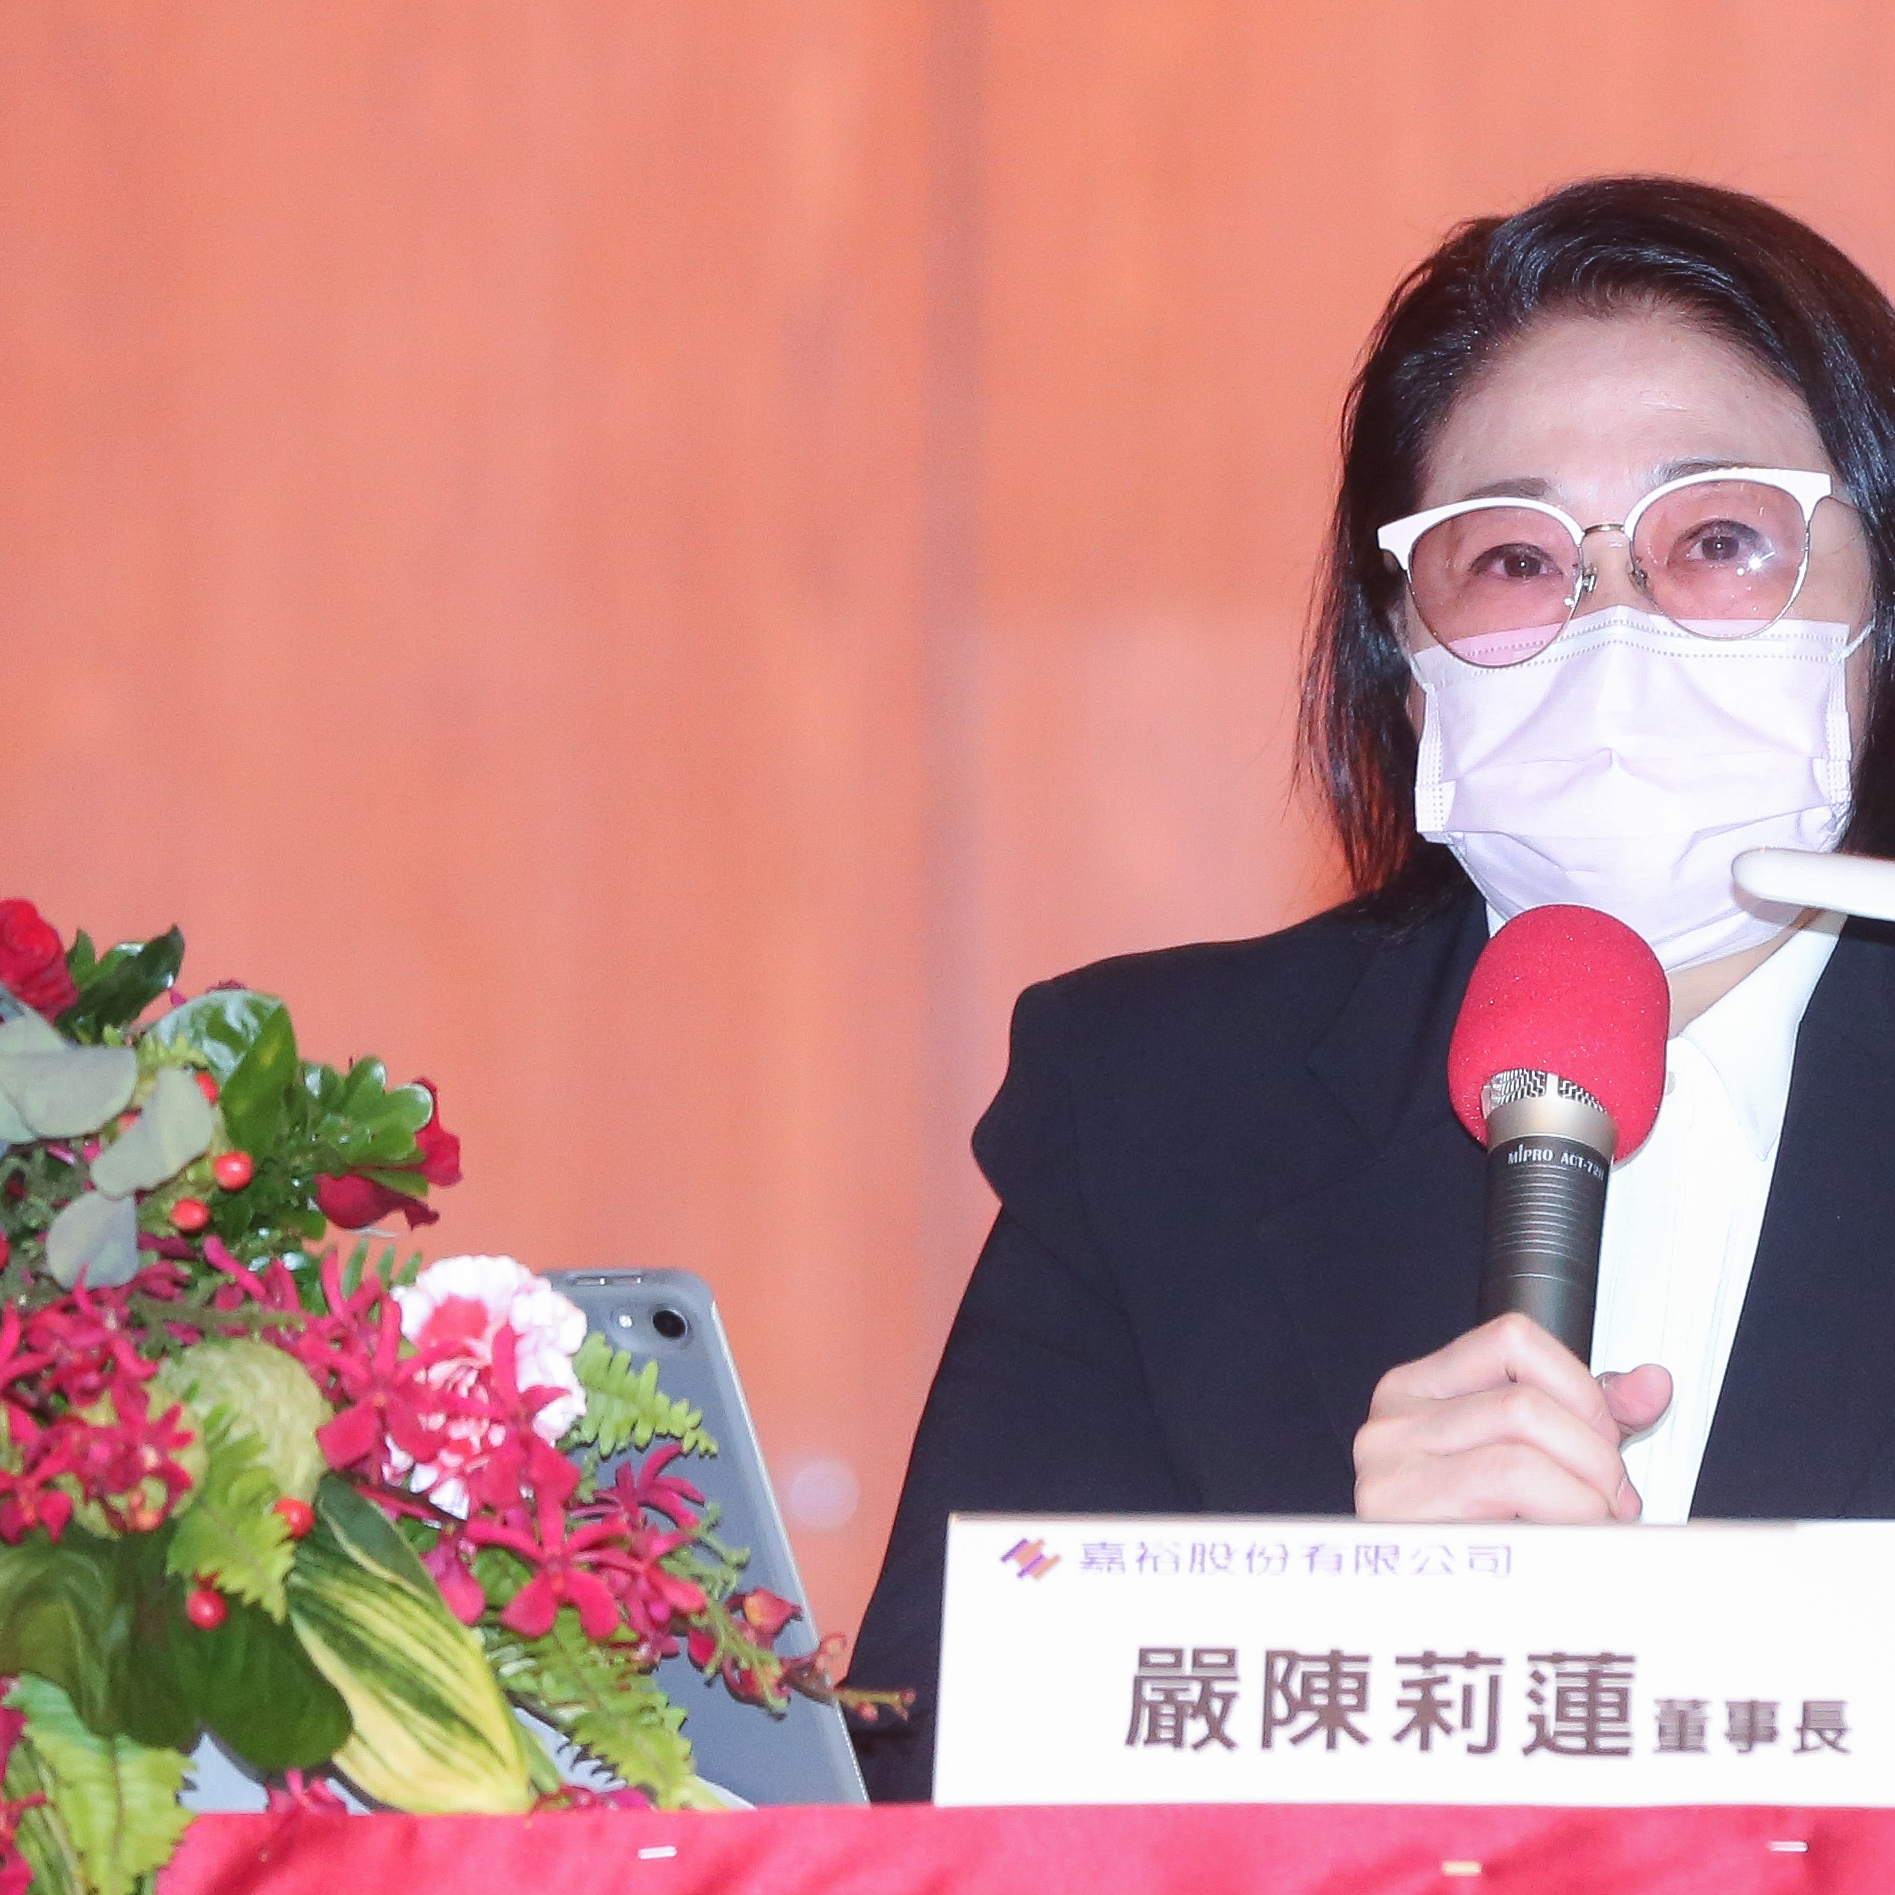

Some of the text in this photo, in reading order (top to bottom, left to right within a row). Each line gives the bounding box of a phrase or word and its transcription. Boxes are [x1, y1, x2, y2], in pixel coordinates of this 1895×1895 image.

[1079, 1540, 1513, 1576] 嘉裕股份有限公司
[1124, 1646, 1852, 1759] 嚴陳莉蓮 董事長
